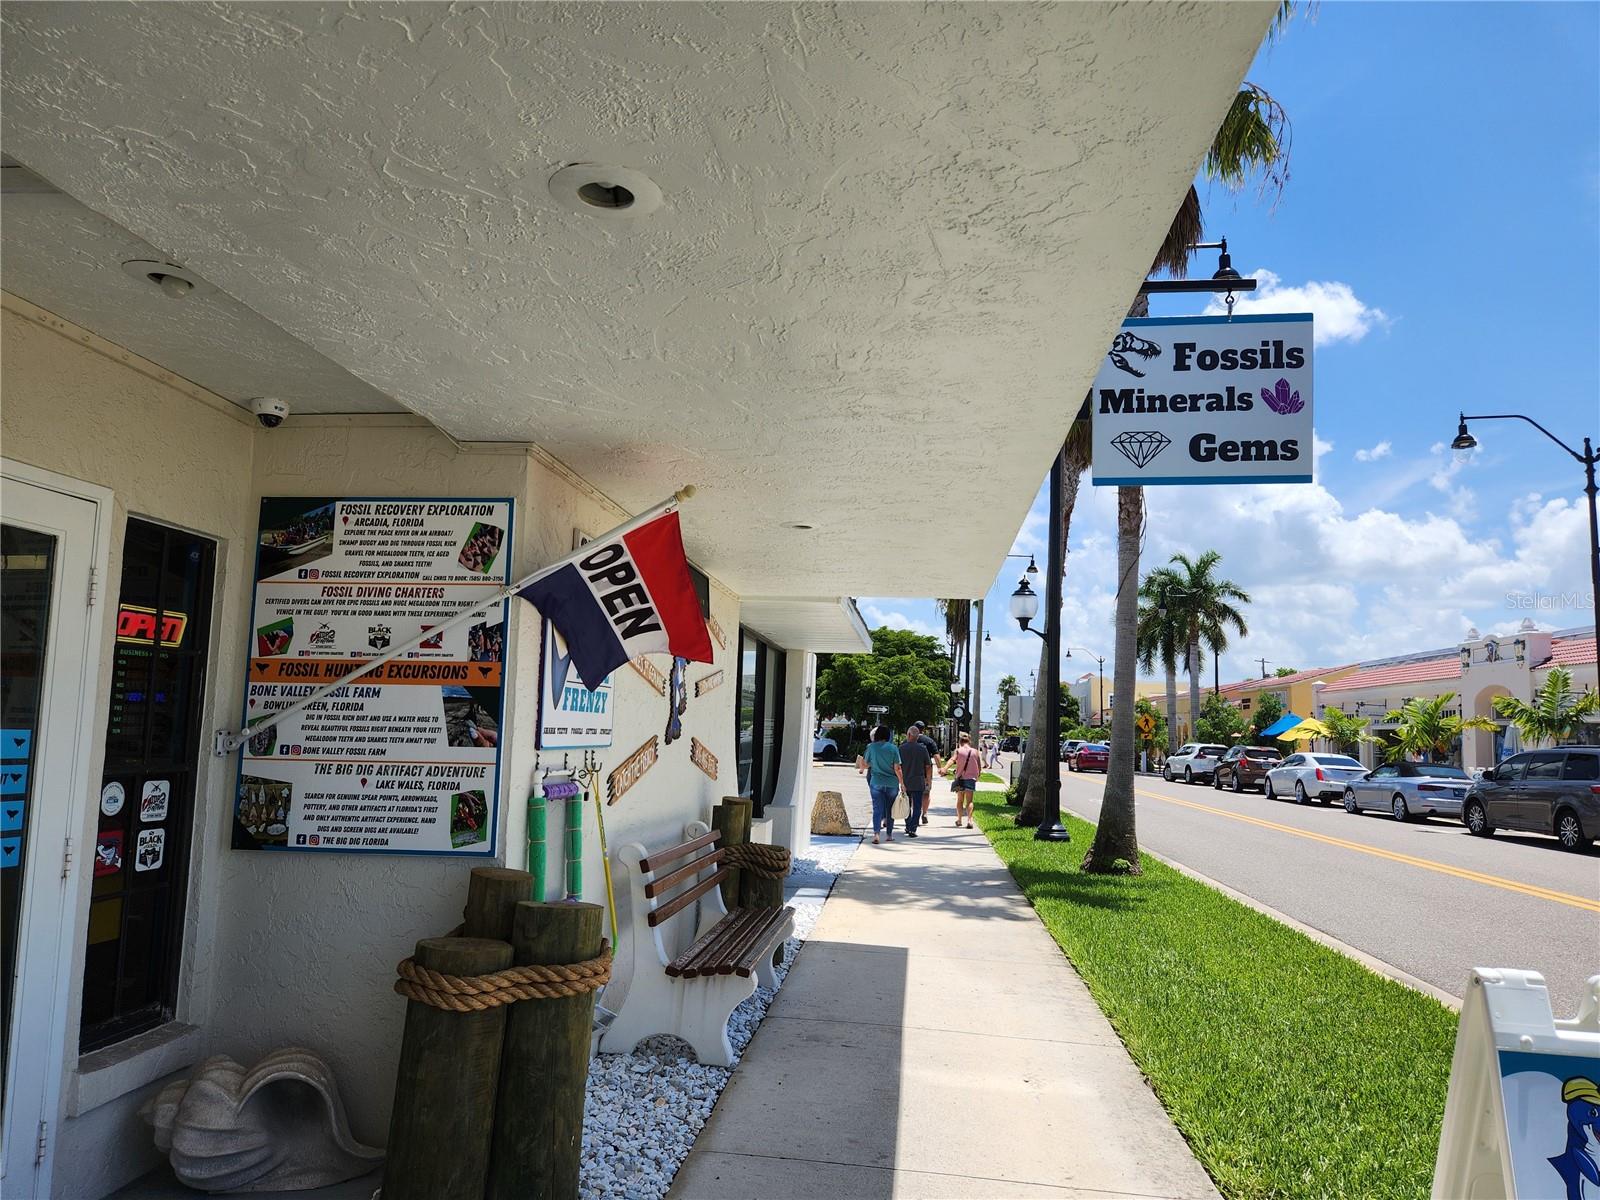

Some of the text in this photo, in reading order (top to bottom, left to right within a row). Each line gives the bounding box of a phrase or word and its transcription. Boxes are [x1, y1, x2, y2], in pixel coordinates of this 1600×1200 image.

[1173, 340, 1304, 372] Fossils
[1099, 386, 1254, 414] Minerals
[1188, 433, 1299, 462] Gems
[340, 504, 494, 516] FOSSIL RECOVERY EXPLORATION
[355, 518, 424, 528] ARCADIA, FLORIDA
[321, 586, 445, 598] FOSSIL DIVING CHARTERS
[579, 543, 662, 640] OPEN
[278, 663, 468, 679] FOSSIL HUNNG EXCURSIONS
[250, 685, 277, 696] BONE
[280, 686, 315, 697] VALLEY
[353, 687, 381, 698] FARM
[263, 701, 297, 710] BOWLIN
[332, 702, 364, 711] FLORIDA
[563, 687, 608, 713] FRENZY
[315, 764, 485, 778] THE BIG DIG ARTIFACT ADVENTURE
[376, 780, 460, 791] LAKE WALES, FLORIDA
[139, 835, 162, 846] BLACK
